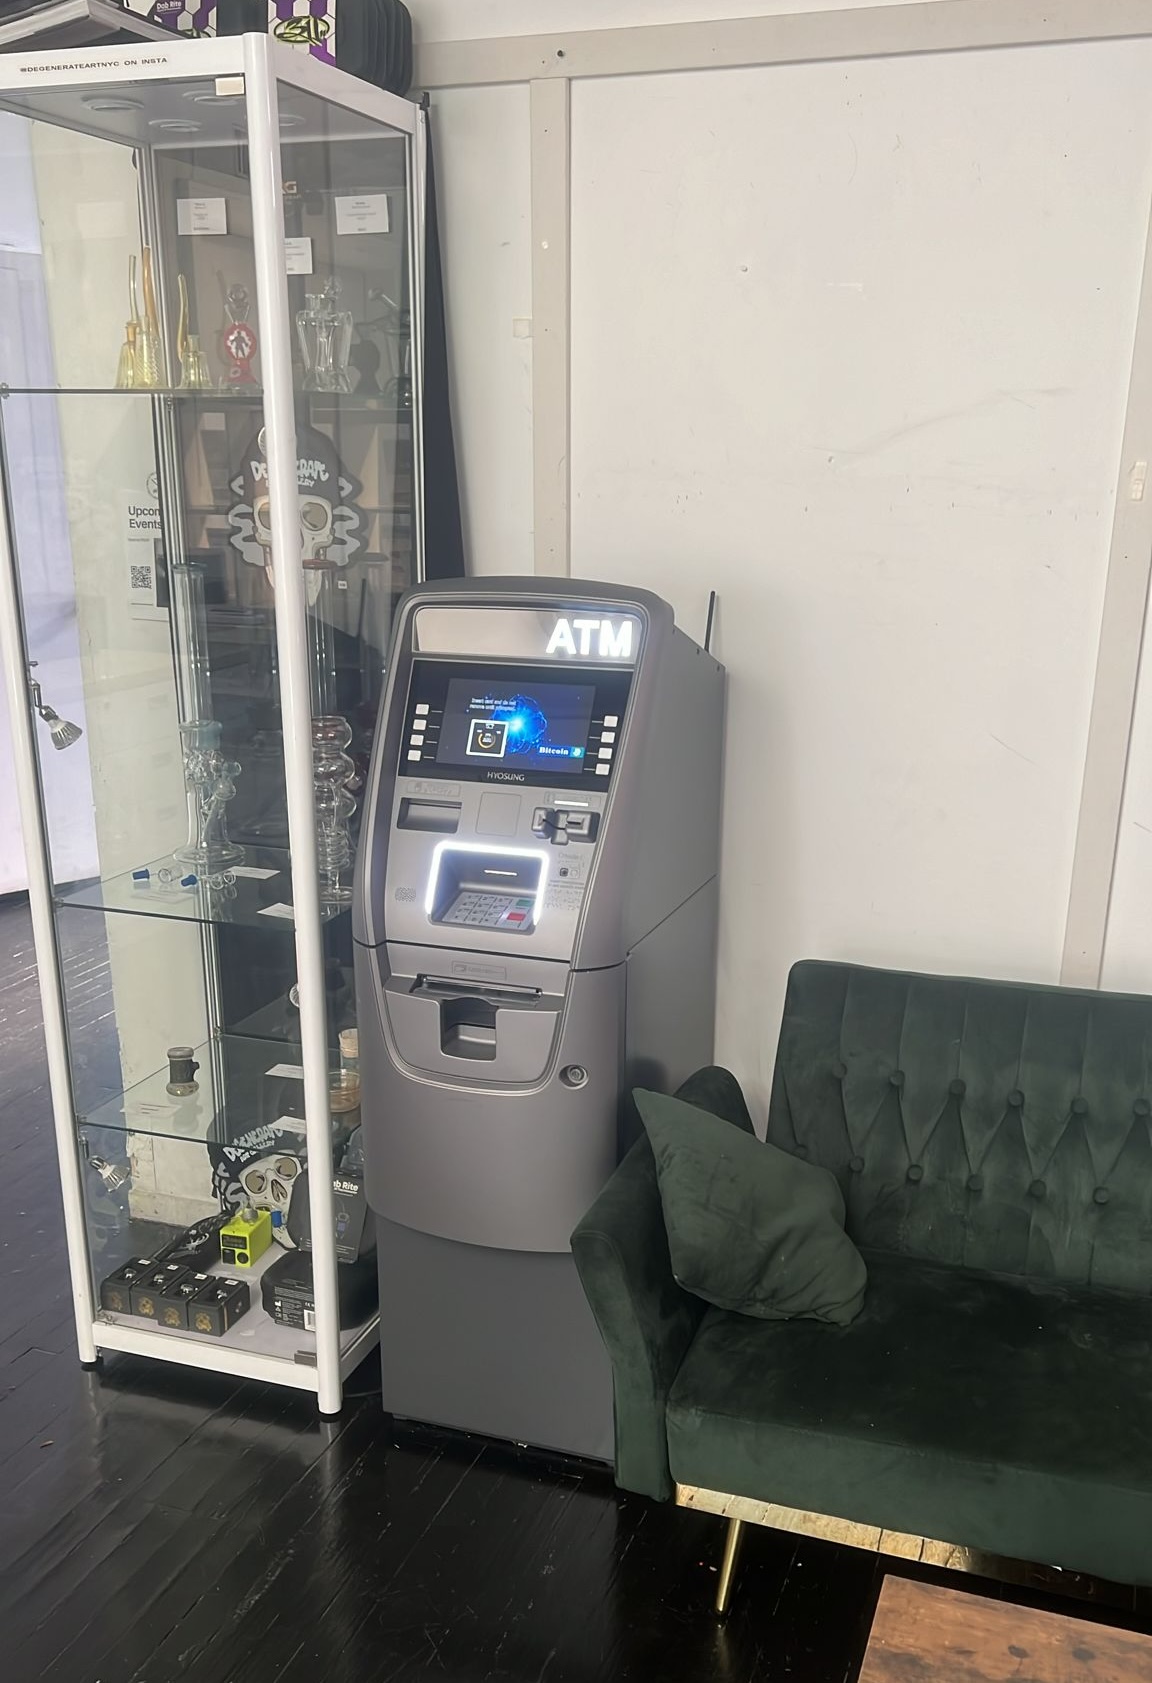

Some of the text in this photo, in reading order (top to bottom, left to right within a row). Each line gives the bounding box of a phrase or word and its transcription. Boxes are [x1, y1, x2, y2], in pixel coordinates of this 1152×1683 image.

[141, 57, 168, 65] INSTA
[545, 618, 633, 658] ATM
[538, 746, 569, 756] Bitcoin
[486, 771, 525, 782] HYOSUNG
[342, 1181, 359, 1192] Rite
